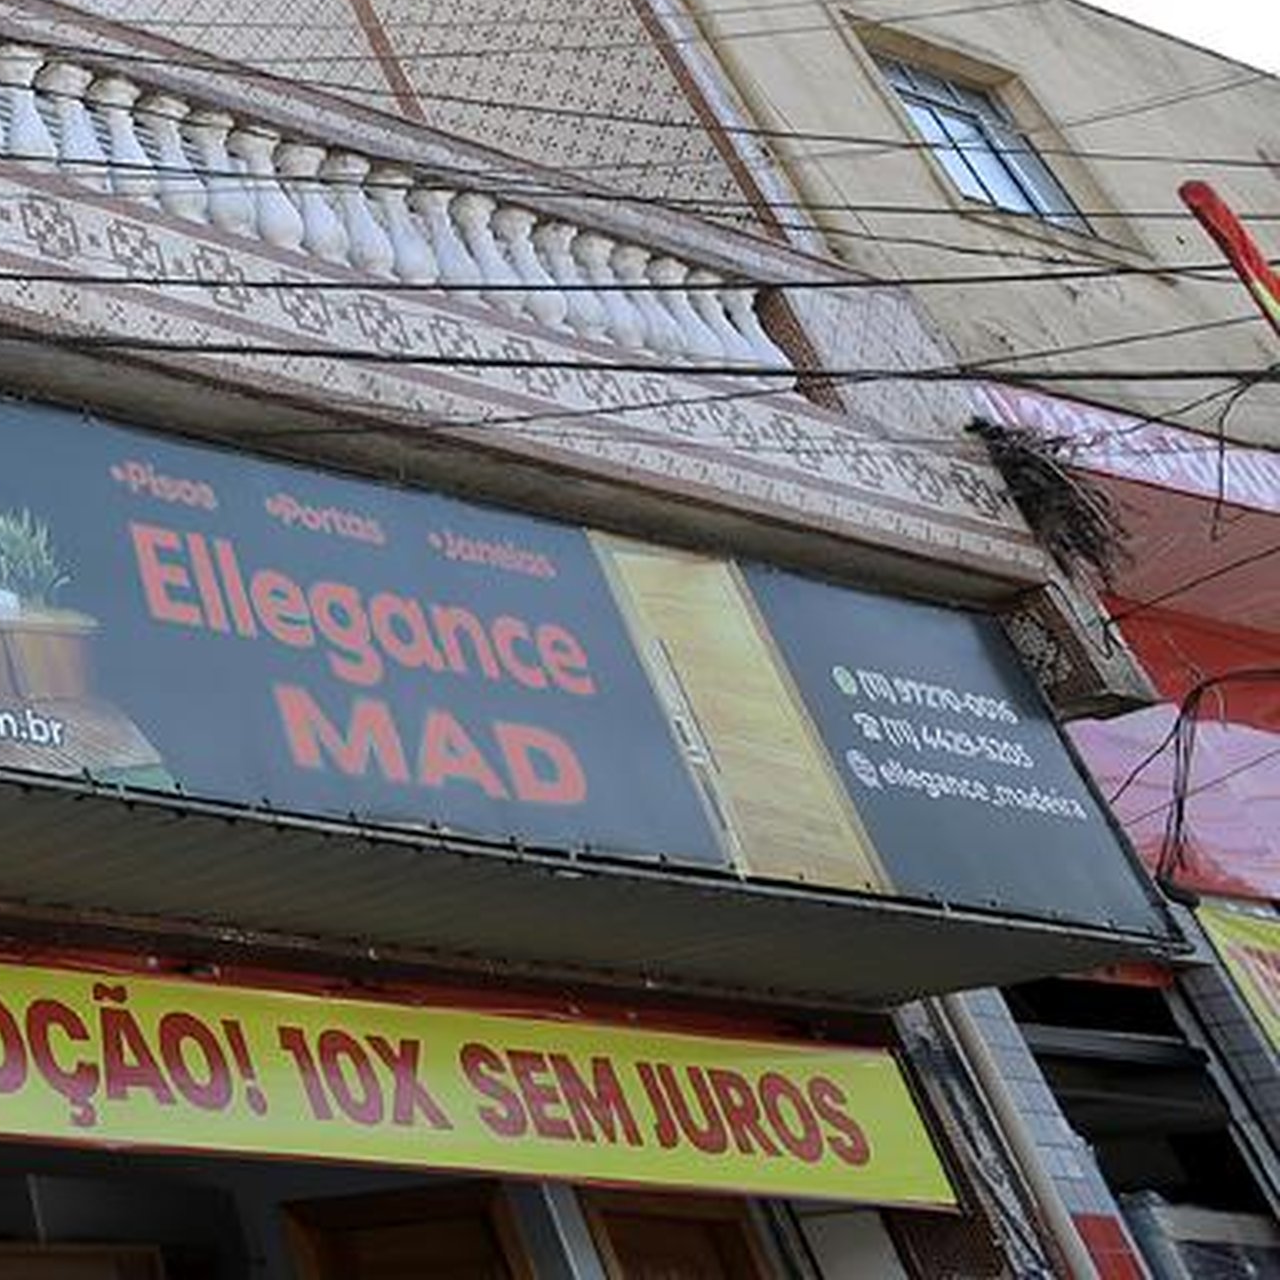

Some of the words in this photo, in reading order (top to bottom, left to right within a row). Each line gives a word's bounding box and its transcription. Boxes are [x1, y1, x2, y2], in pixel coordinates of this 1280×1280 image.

[125, 460, 218, 511] Pisos
[278, 493, 387, 546] Portas
[444, 532, 557, 578] Janelas
[129, 522, 598, 696] Ellegance
[273, 683, 588, 806] MAD
[277, 1025, 453, 1130] 10X
[458, 1042, 644, 1148] SEM
[638, 1060, 871, 1168] JUROS
